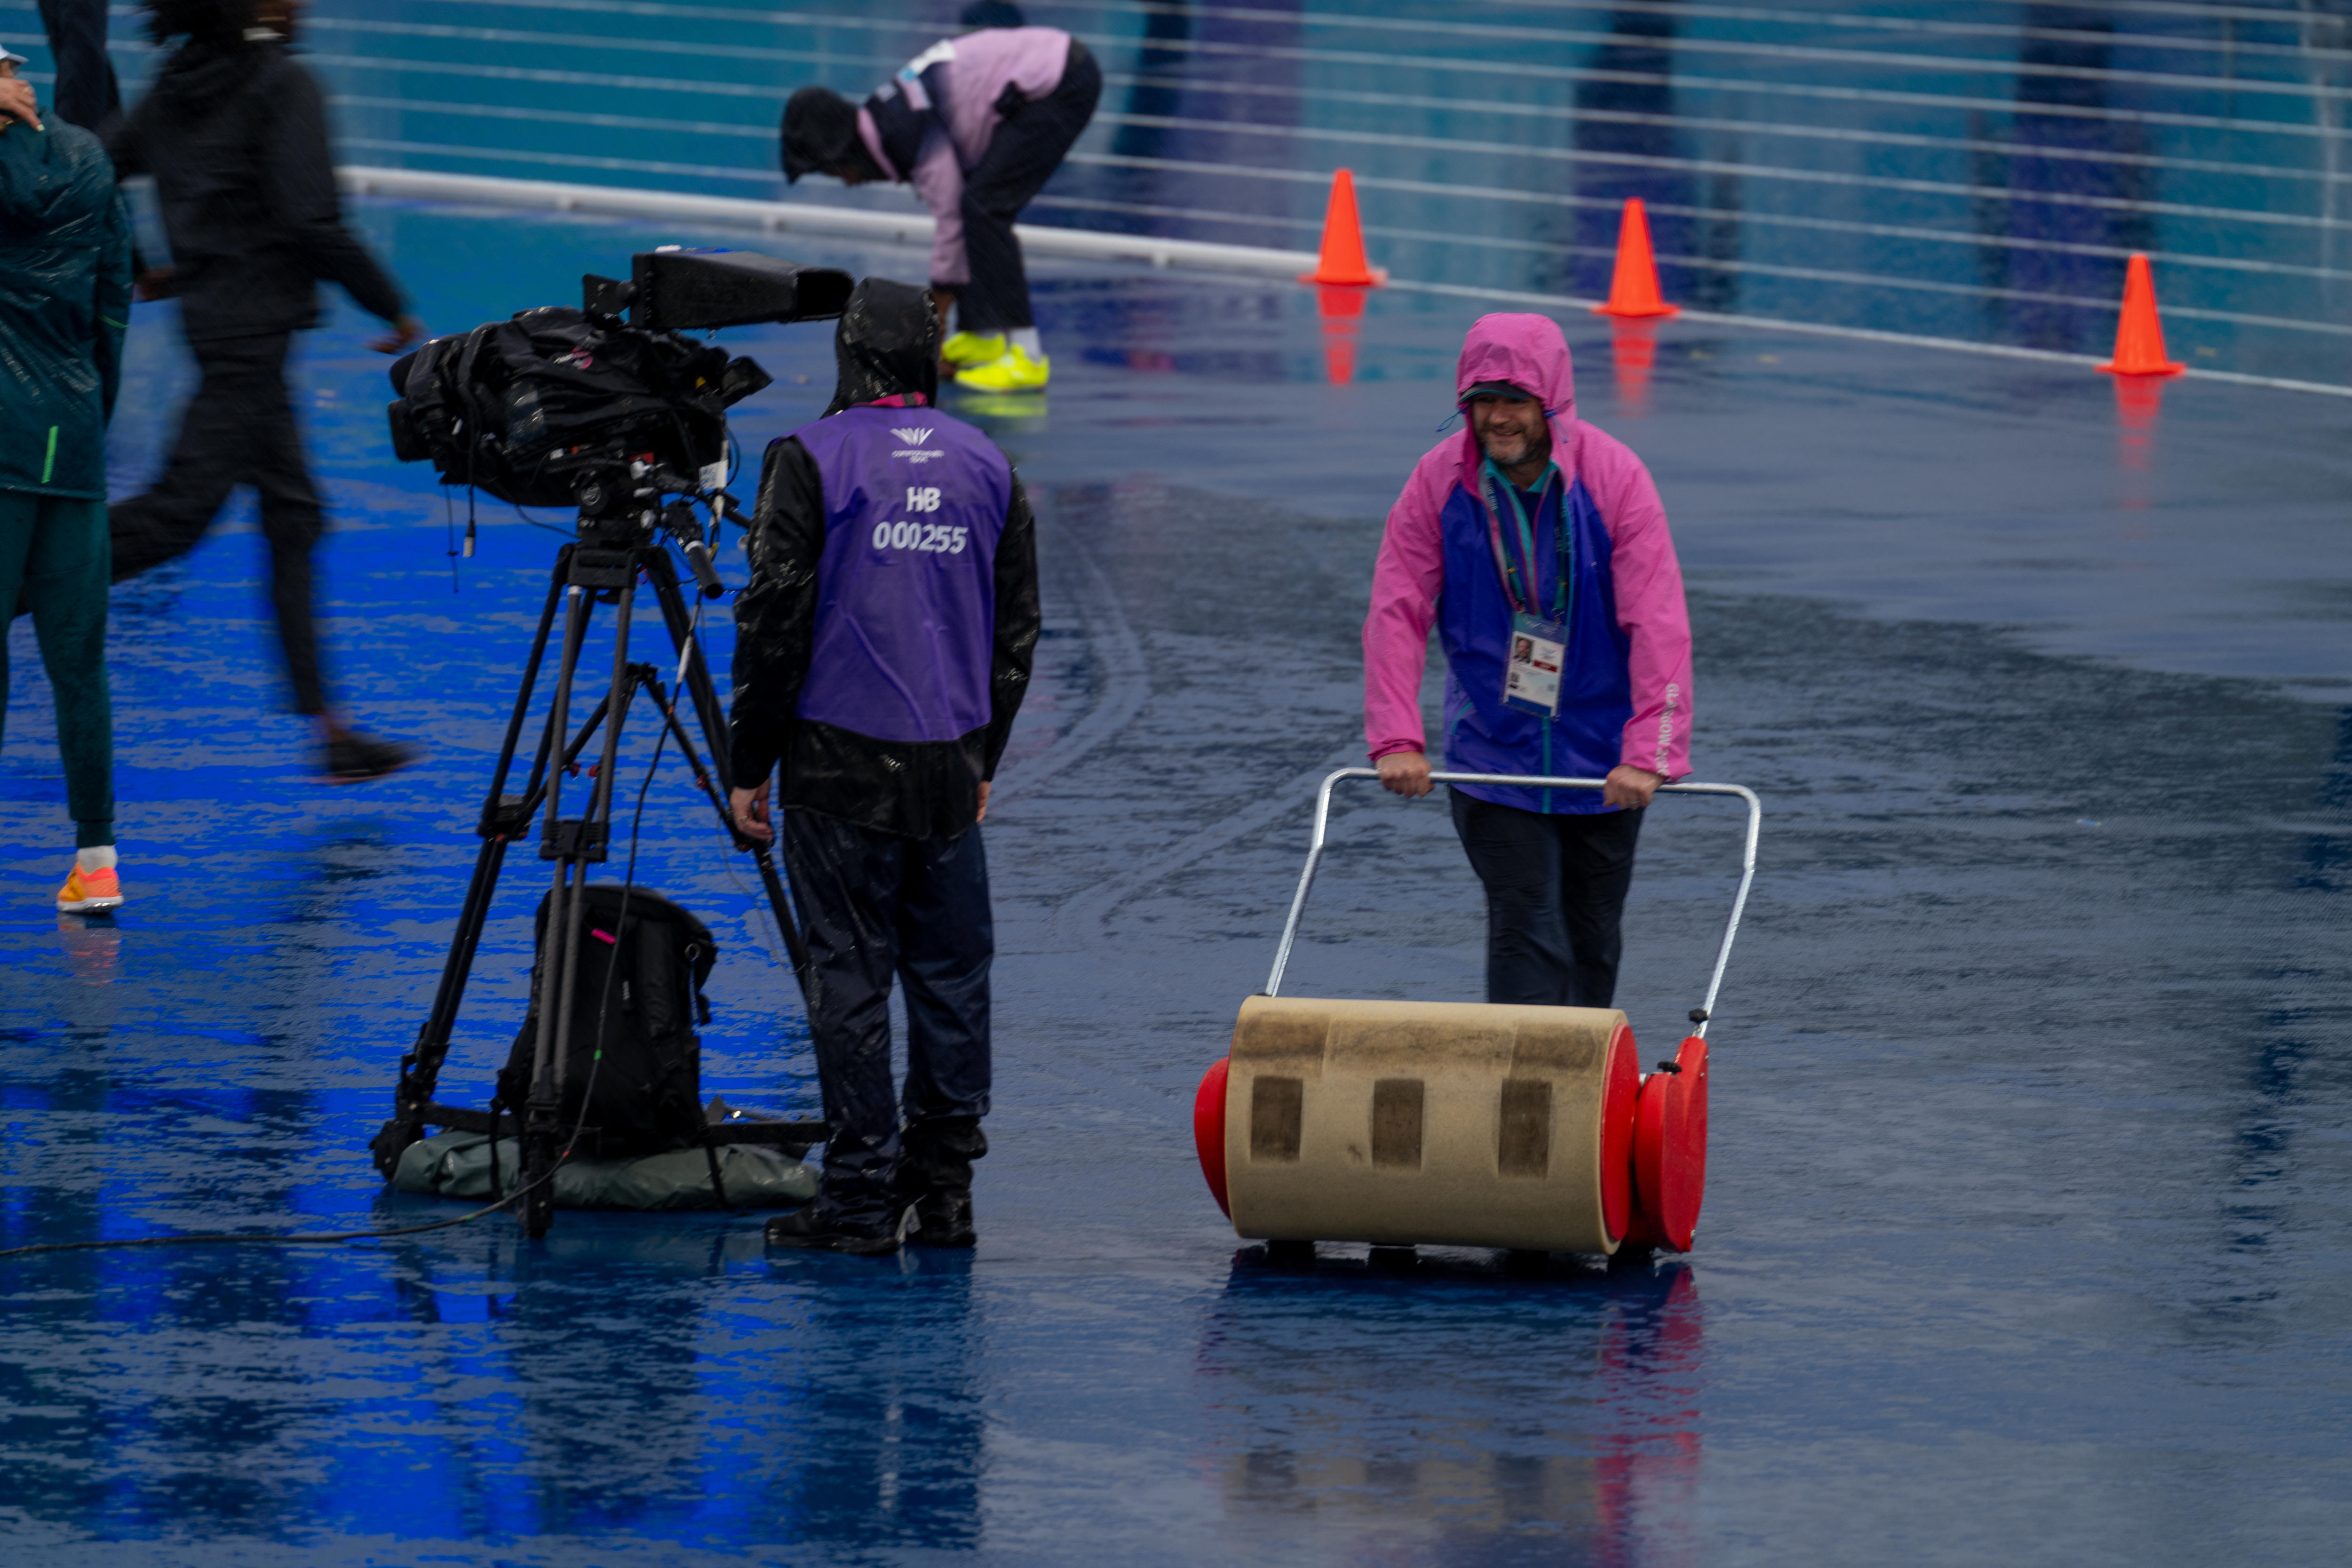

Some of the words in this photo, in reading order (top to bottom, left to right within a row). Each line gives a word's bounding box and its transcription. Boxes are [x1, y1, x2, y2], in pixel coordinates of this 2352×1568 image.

[906, 486, 941, 512] HB
[872, 521, 969, 554] 000255
[1658, 683, 1679, 746] GLASGOW
